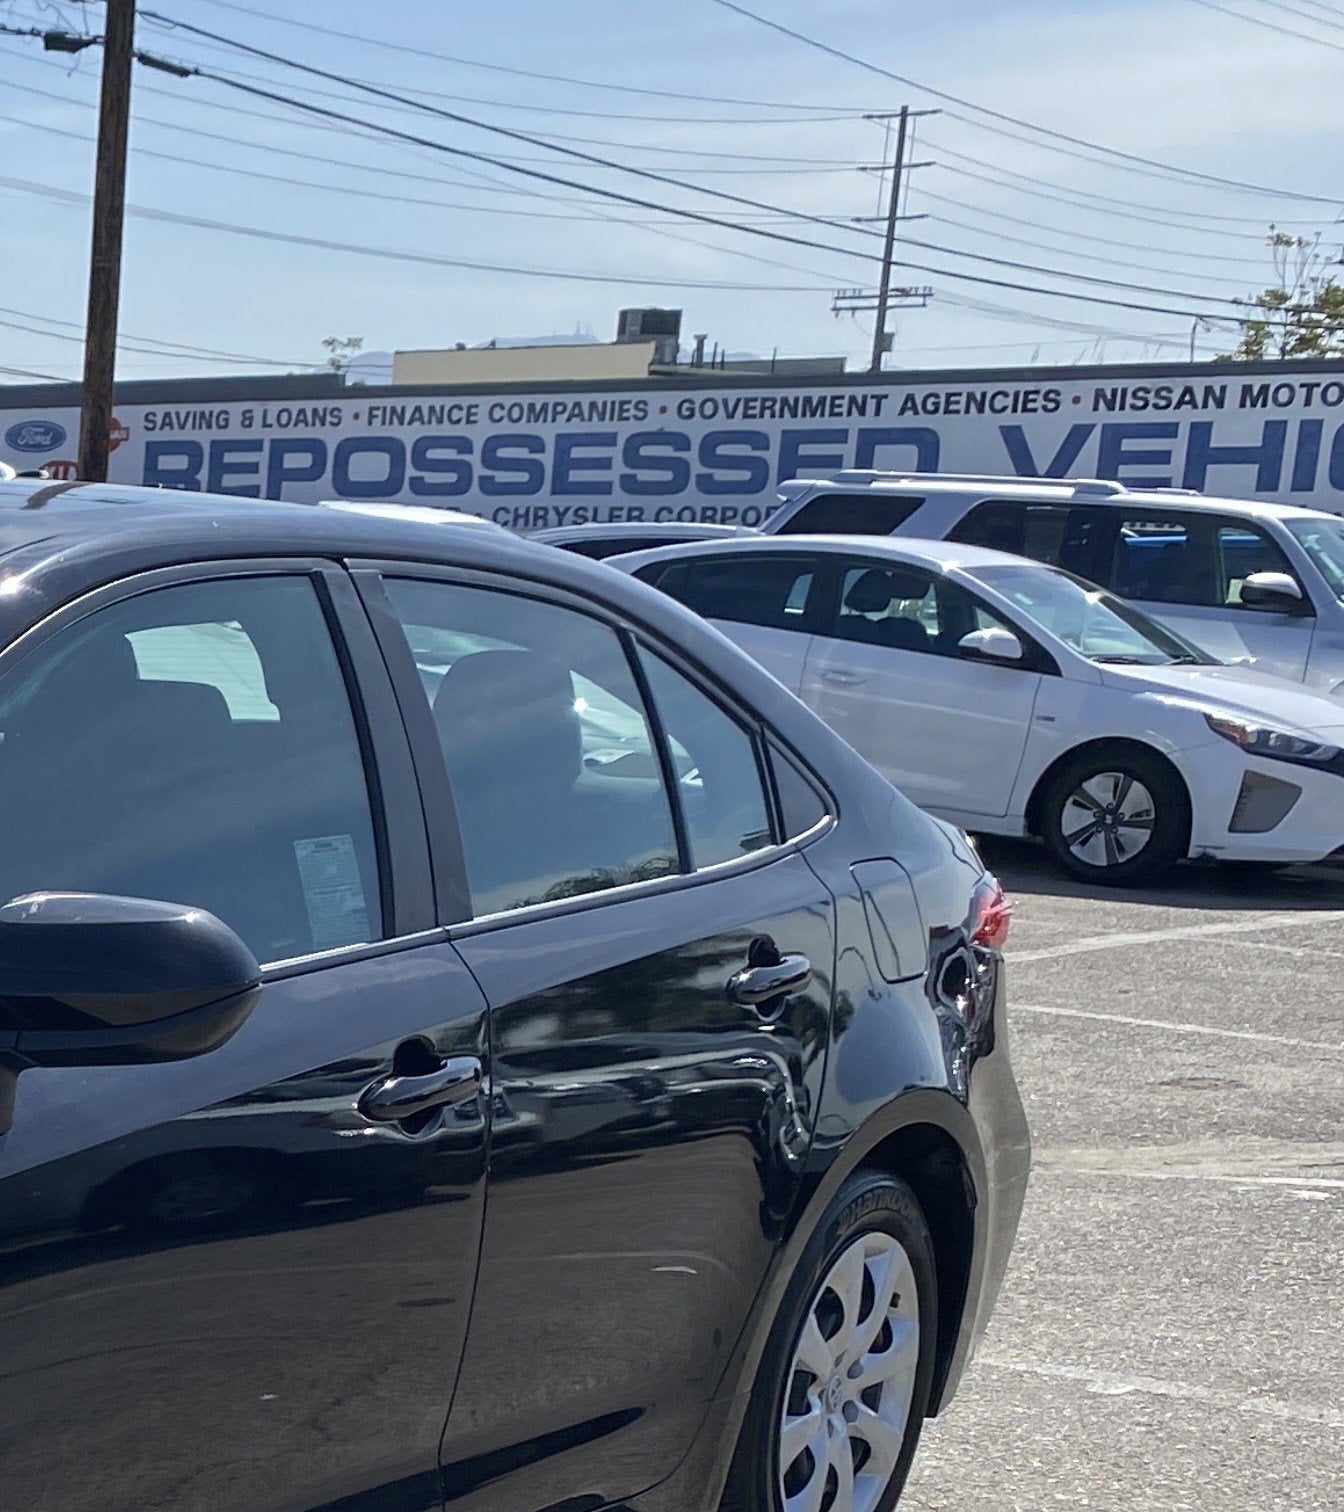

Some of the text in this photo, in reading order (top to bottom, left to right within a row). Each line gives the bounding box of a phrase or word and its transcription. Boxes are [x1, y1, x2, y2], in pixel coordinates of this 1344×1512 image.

[143, 381, 1344, 431] SAVING & LOANS FINANCE COMPANIES GOVERNMENT AGENCIES NISSAN MOTO
[17, 426, 53, 446] Ford
[142, 418, 1344, 501] REPOSSESSED VEHI
[492, 505, 645, 528] CHRYSLER
